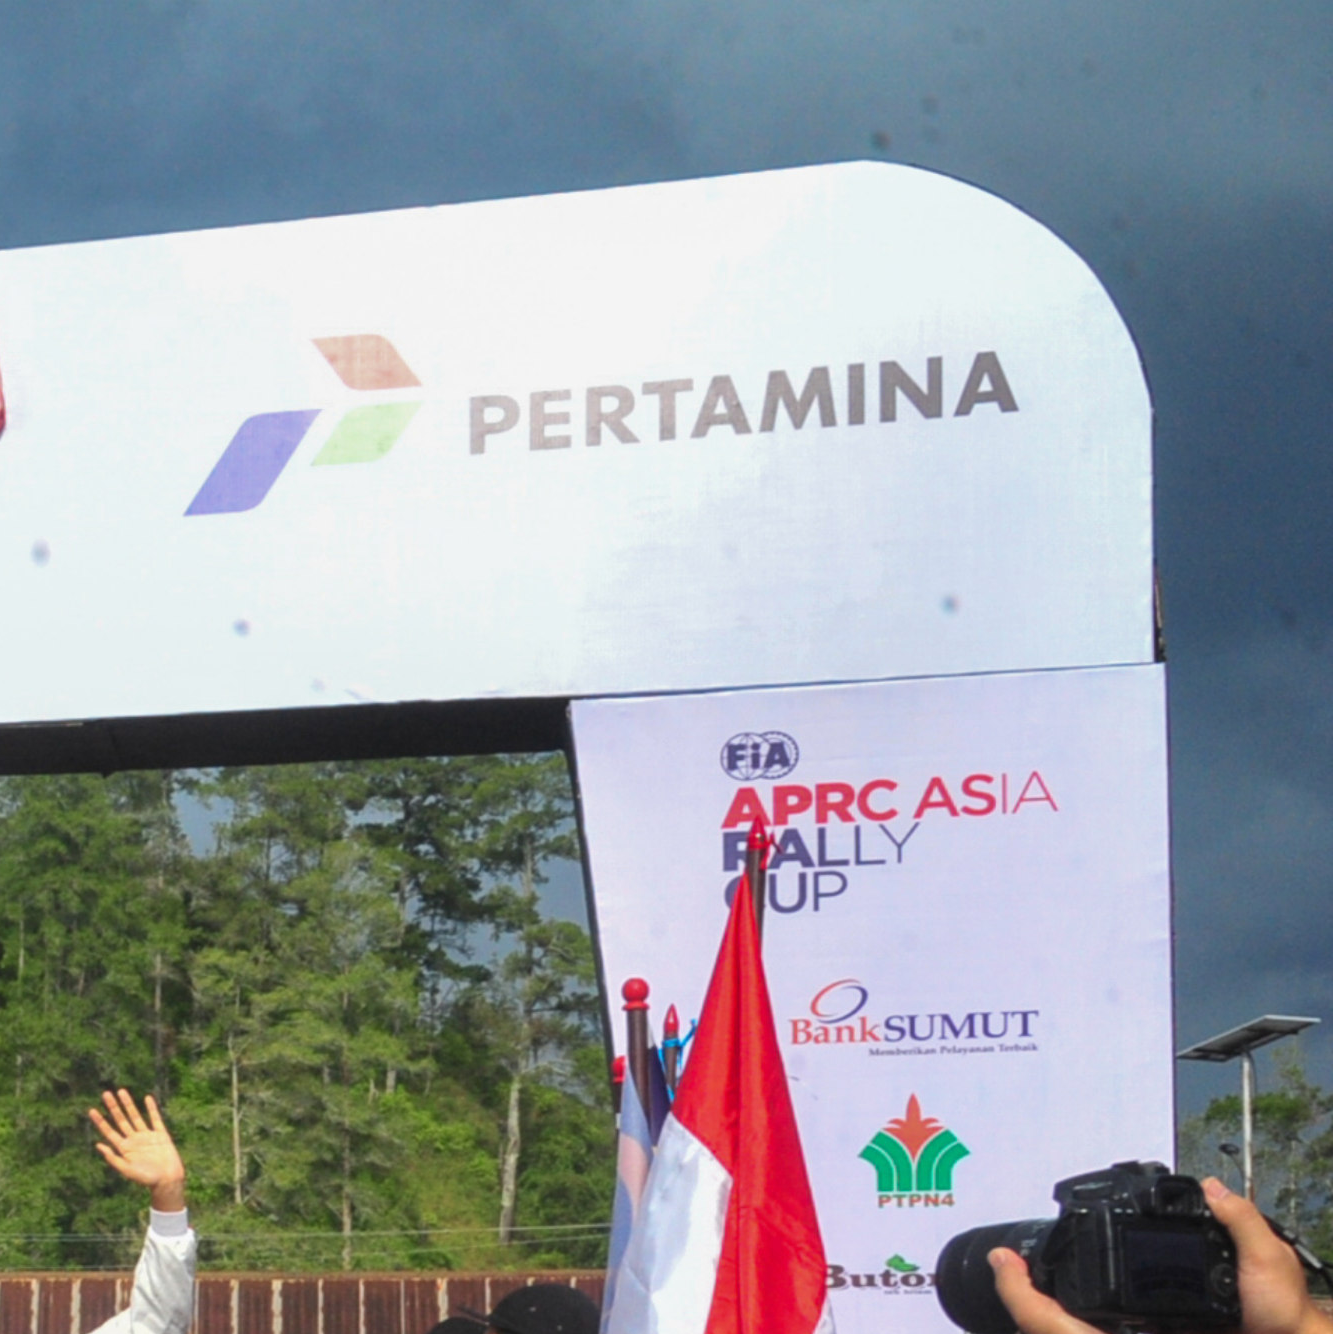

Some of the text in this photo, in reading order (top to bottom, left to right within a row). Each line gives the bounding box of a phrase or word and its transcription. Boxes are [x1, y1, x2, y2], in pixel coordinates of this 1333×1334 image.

[468, 350, 1021, 456] PERTAMINA
[721, 771, 1059, 829] APRC ASIA
[722, 821, 920, 872] RALLY
[877, 1193, 955, 1209] PTPN4
